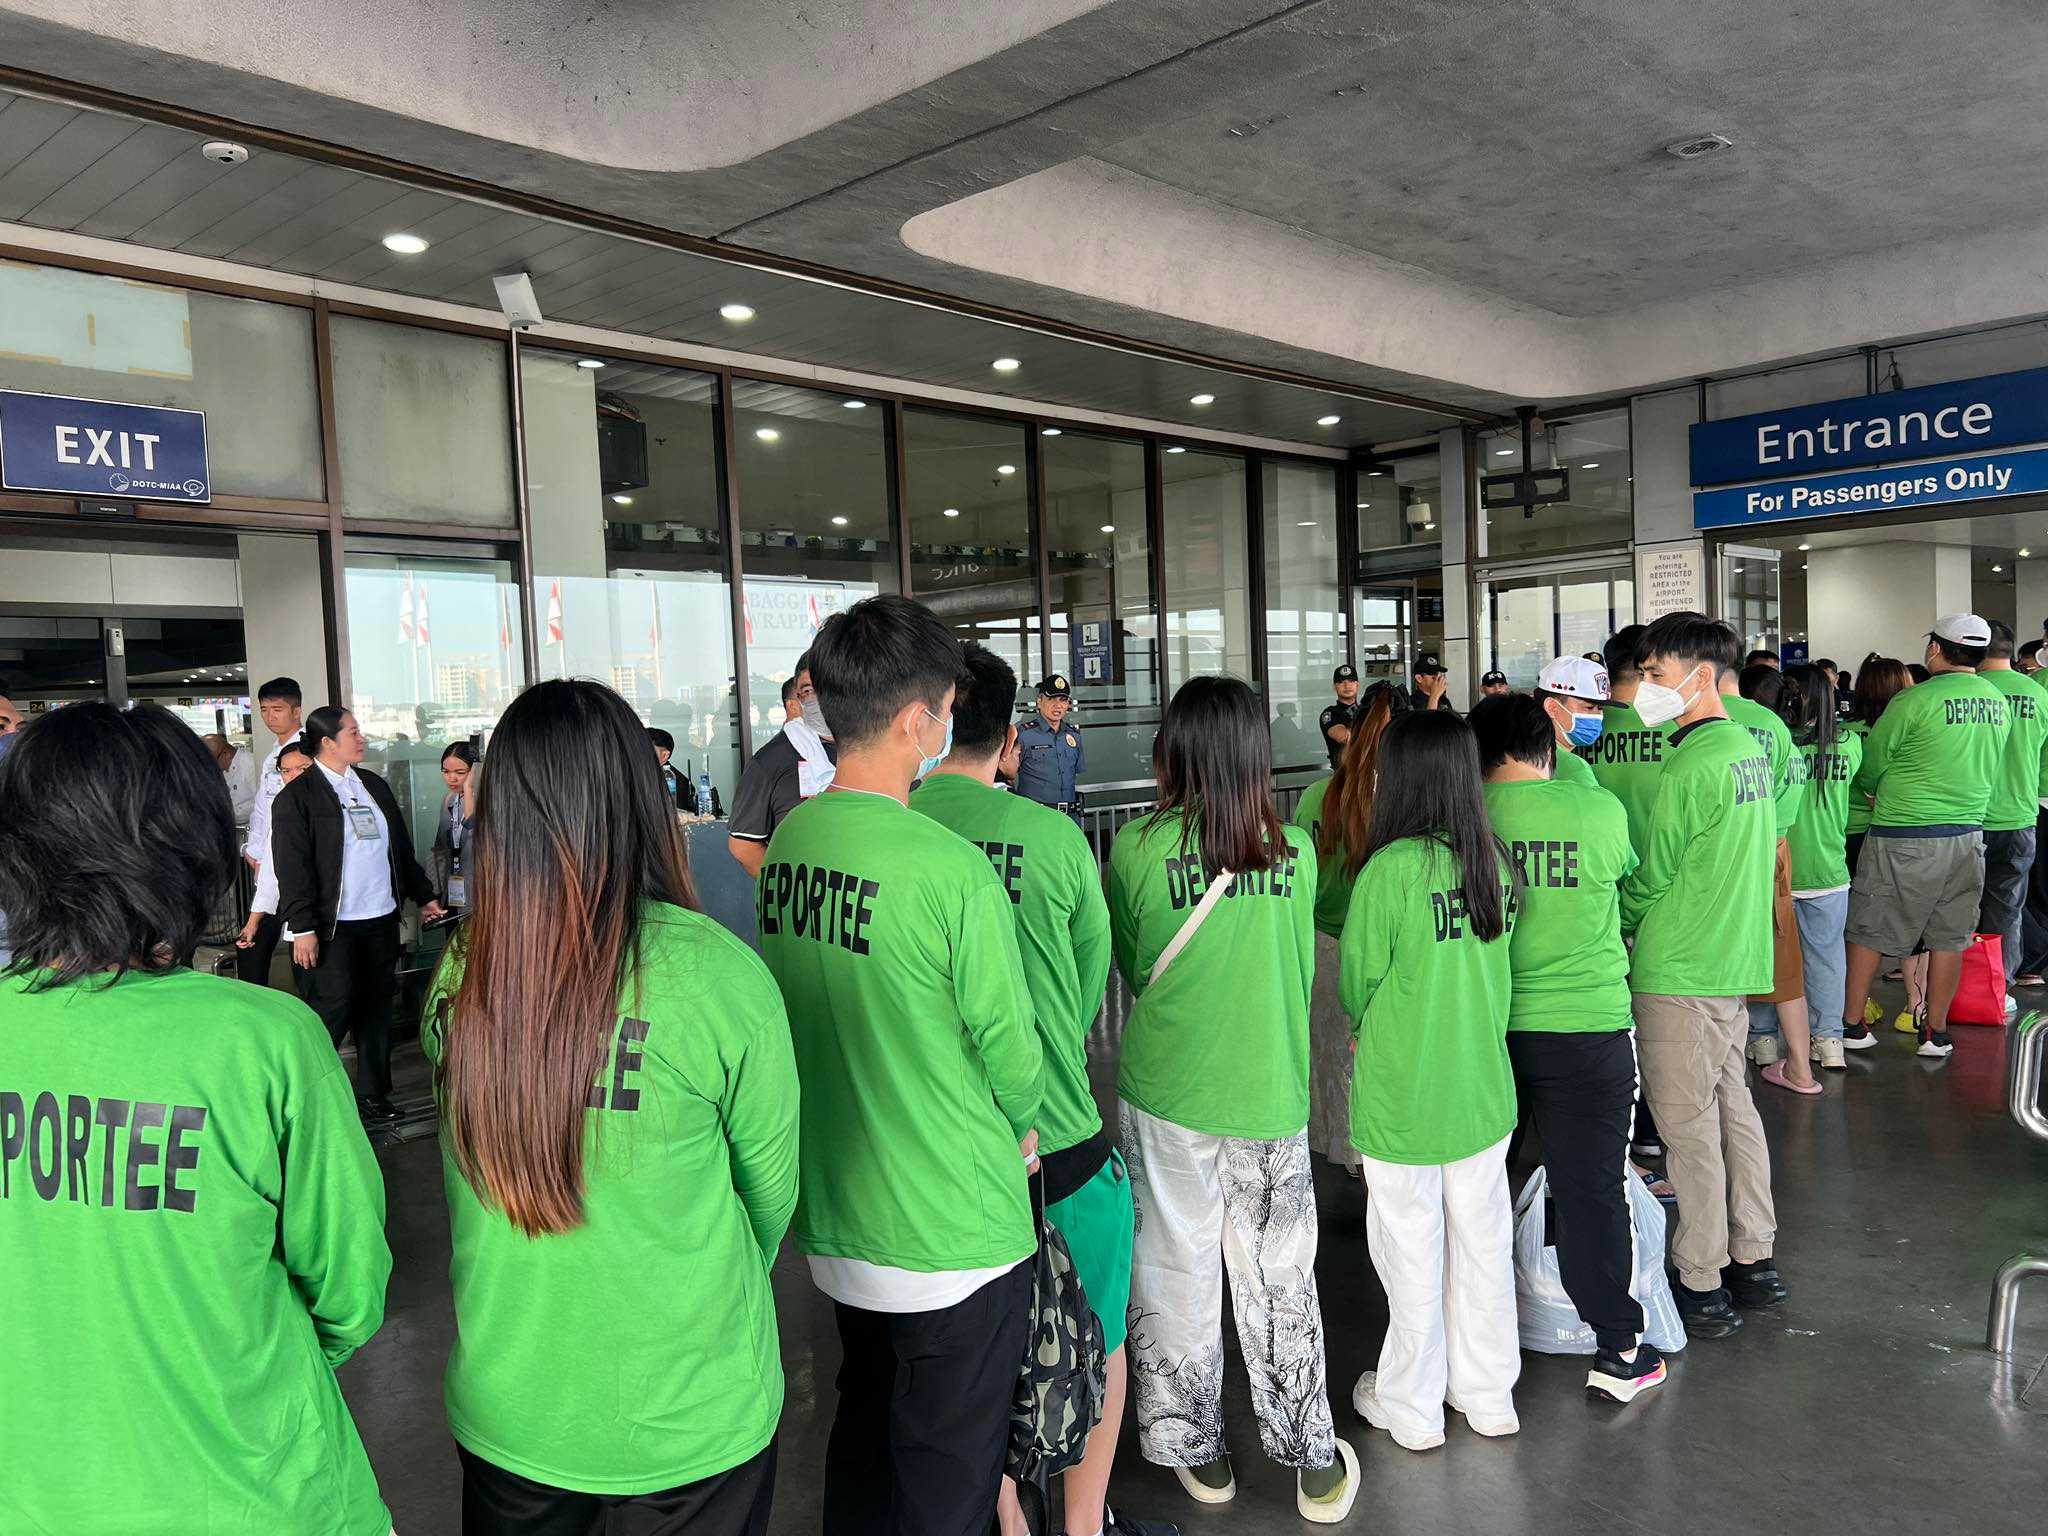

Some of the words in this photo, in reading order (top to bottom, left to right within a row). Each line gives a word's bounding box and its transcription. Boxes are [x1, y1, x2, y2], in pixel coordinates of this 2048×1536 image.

[1757, 402, 1994, 465] Entrance
[55, 425, 160, 470] EXIT
[132, 481, 181, 490] DOTC-MIAA
[1746, 492, 1784, 514] For
[1791, 474, 1938, 508] Passengers
[1945, 463, 2014, 490] Only
[1650, 570, 1693, 579] RESTRICTED
[1650, 597, 1693, 607] HEIGHTENED
